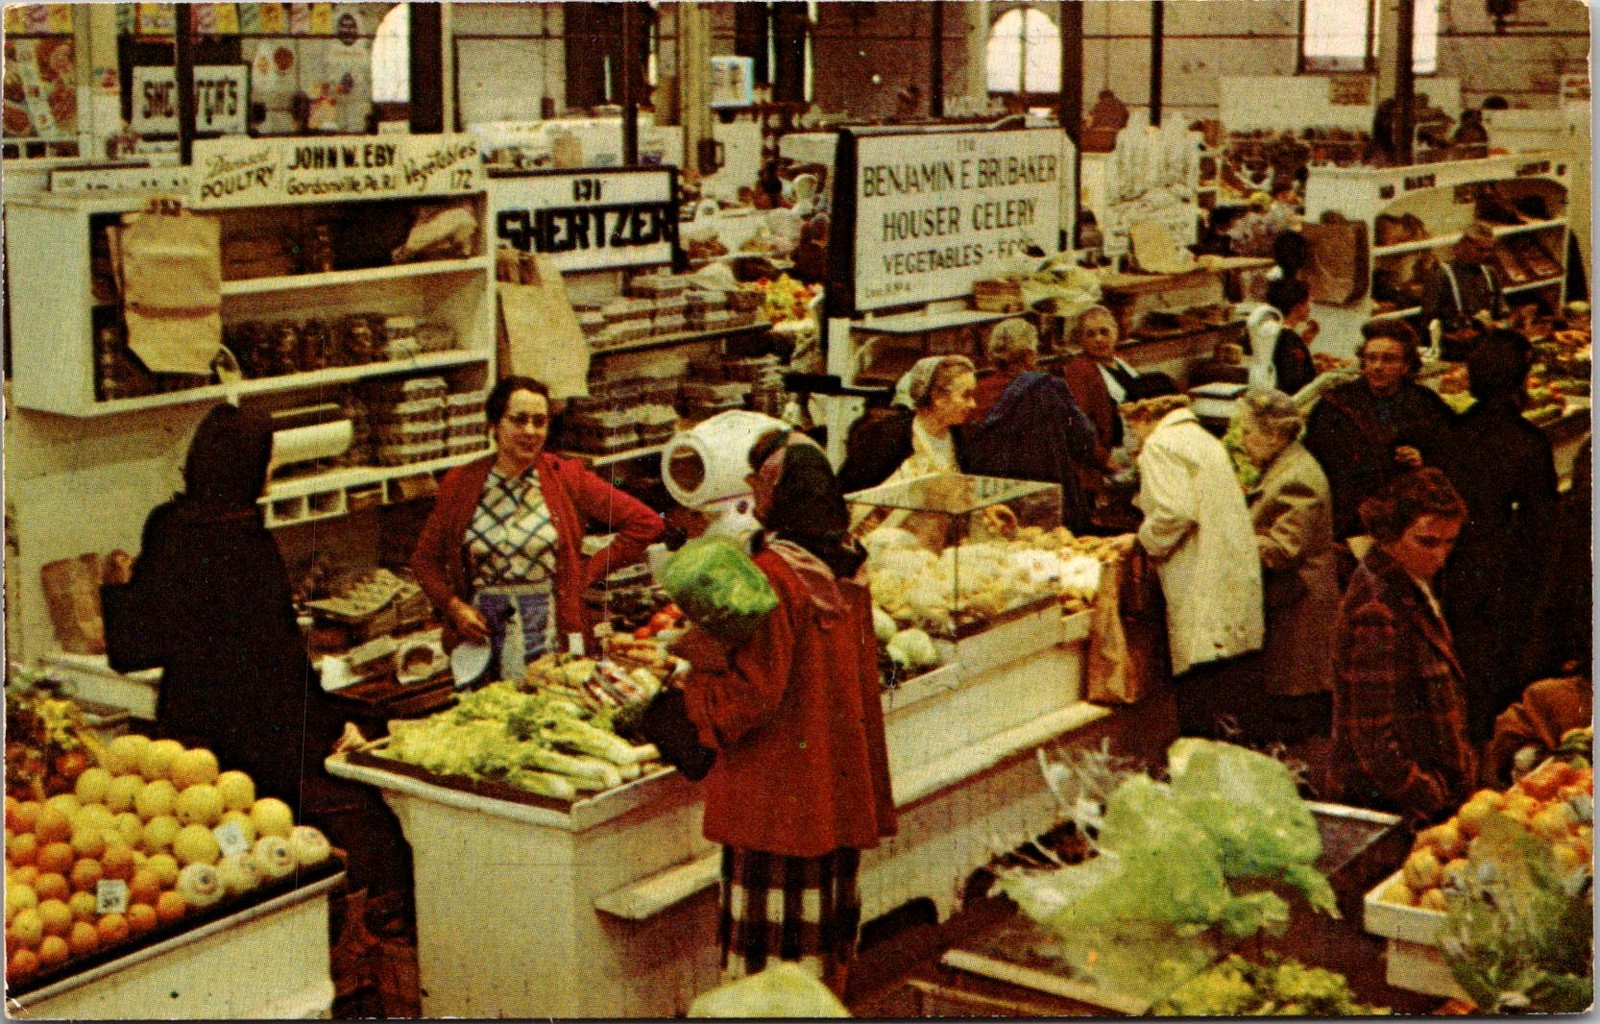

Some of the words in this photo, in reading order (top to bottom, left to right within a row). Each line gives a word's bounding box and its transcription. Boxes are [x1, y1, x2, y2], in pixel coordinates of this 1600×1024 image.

[287, 146, 337, 170] JOHN
[343, 145, 359, 168] W.
[364, 143, 397, 168] EBY
[403, 141, 477, 191] Vegetables
[863, 160, 955, 198] BENJAMIN
[978, 153, 1058, 188] BRUBAKER
[201, 163, 276, 201] POULTRY
[451, 168, 472, 190] 172
[497, 201, 676, 253] SHERTZER
[882, 205, 961, 242] HOUSER
[971, 198, 1038, 231] CELERY
[883, 243, 984, 276] VEGETABLES
